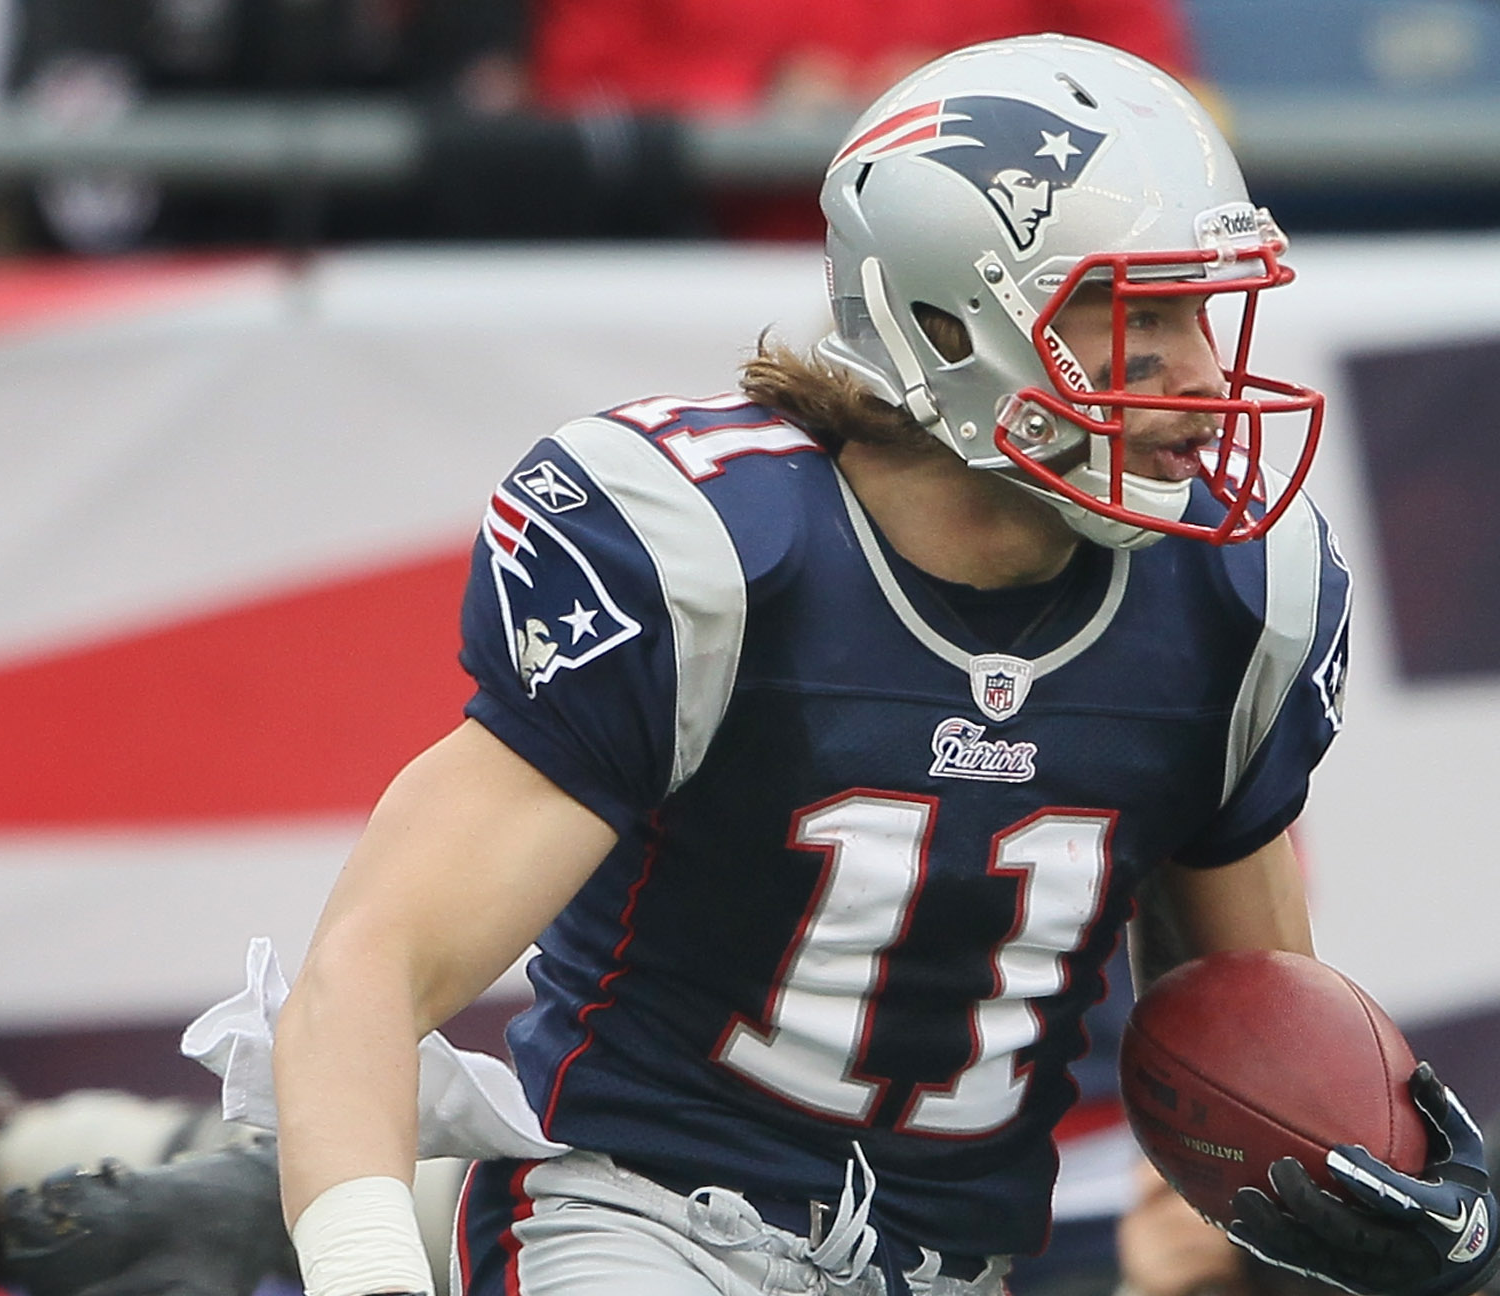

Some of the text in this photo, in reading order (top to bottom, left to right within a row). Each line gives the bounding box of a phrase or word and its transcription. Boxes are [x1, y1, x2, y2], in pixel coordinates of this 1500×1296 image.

[608, 391, 827, 484] 11
[986, 687, 1012, 709] NFL
[937, 736, 1032, 773] Patriots
[709, 786, 1119, 1140] 11
